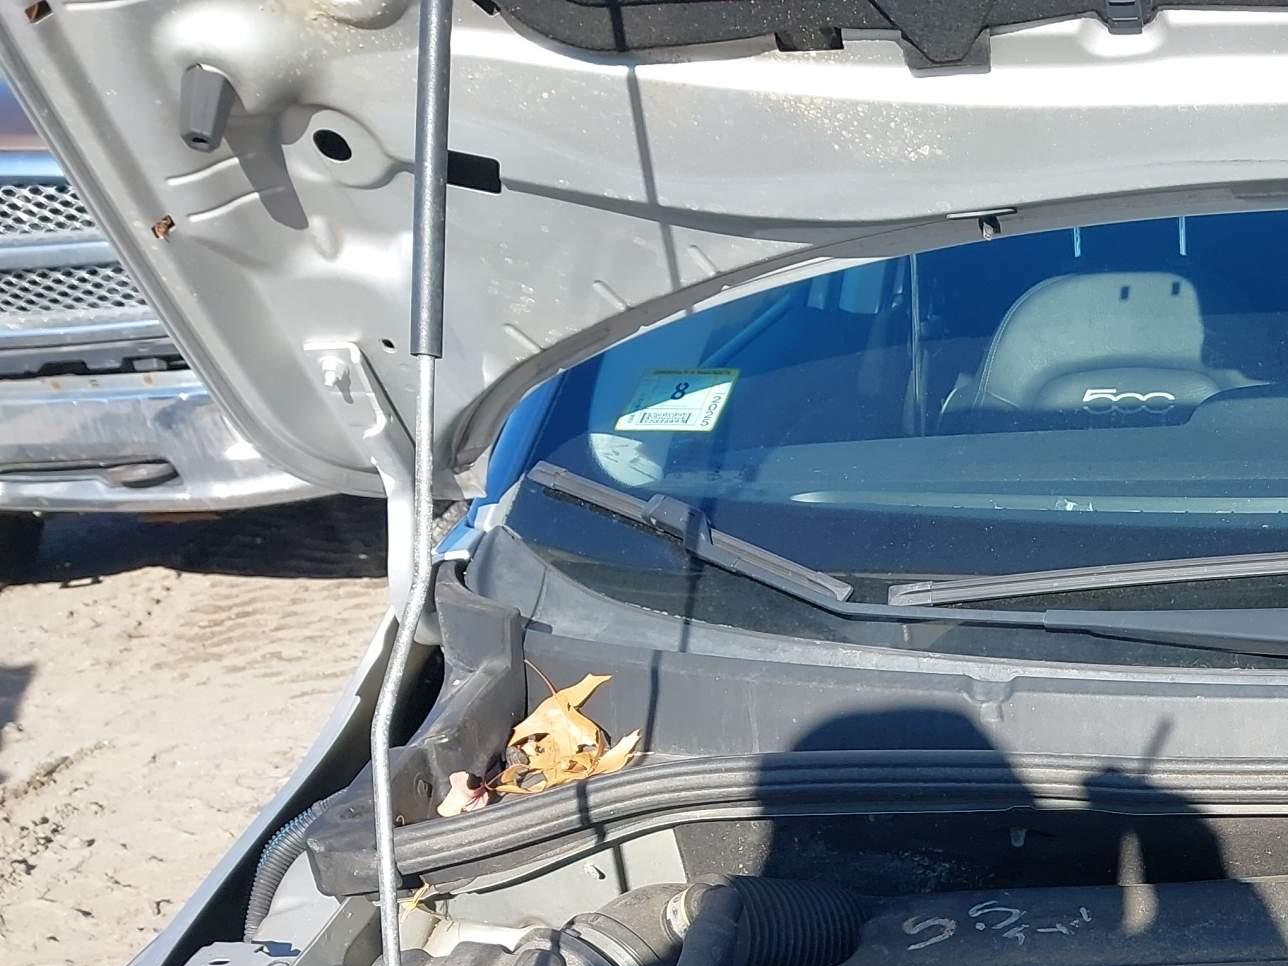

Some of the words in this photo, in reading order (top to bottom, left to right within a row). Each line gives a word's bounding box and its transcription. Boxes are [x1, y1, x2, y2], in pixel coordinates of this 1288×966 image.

[670, 381, 690, 400] 8
[1082, 389, 1175, 414] 500
[700, 395, 723, 427] 2025
